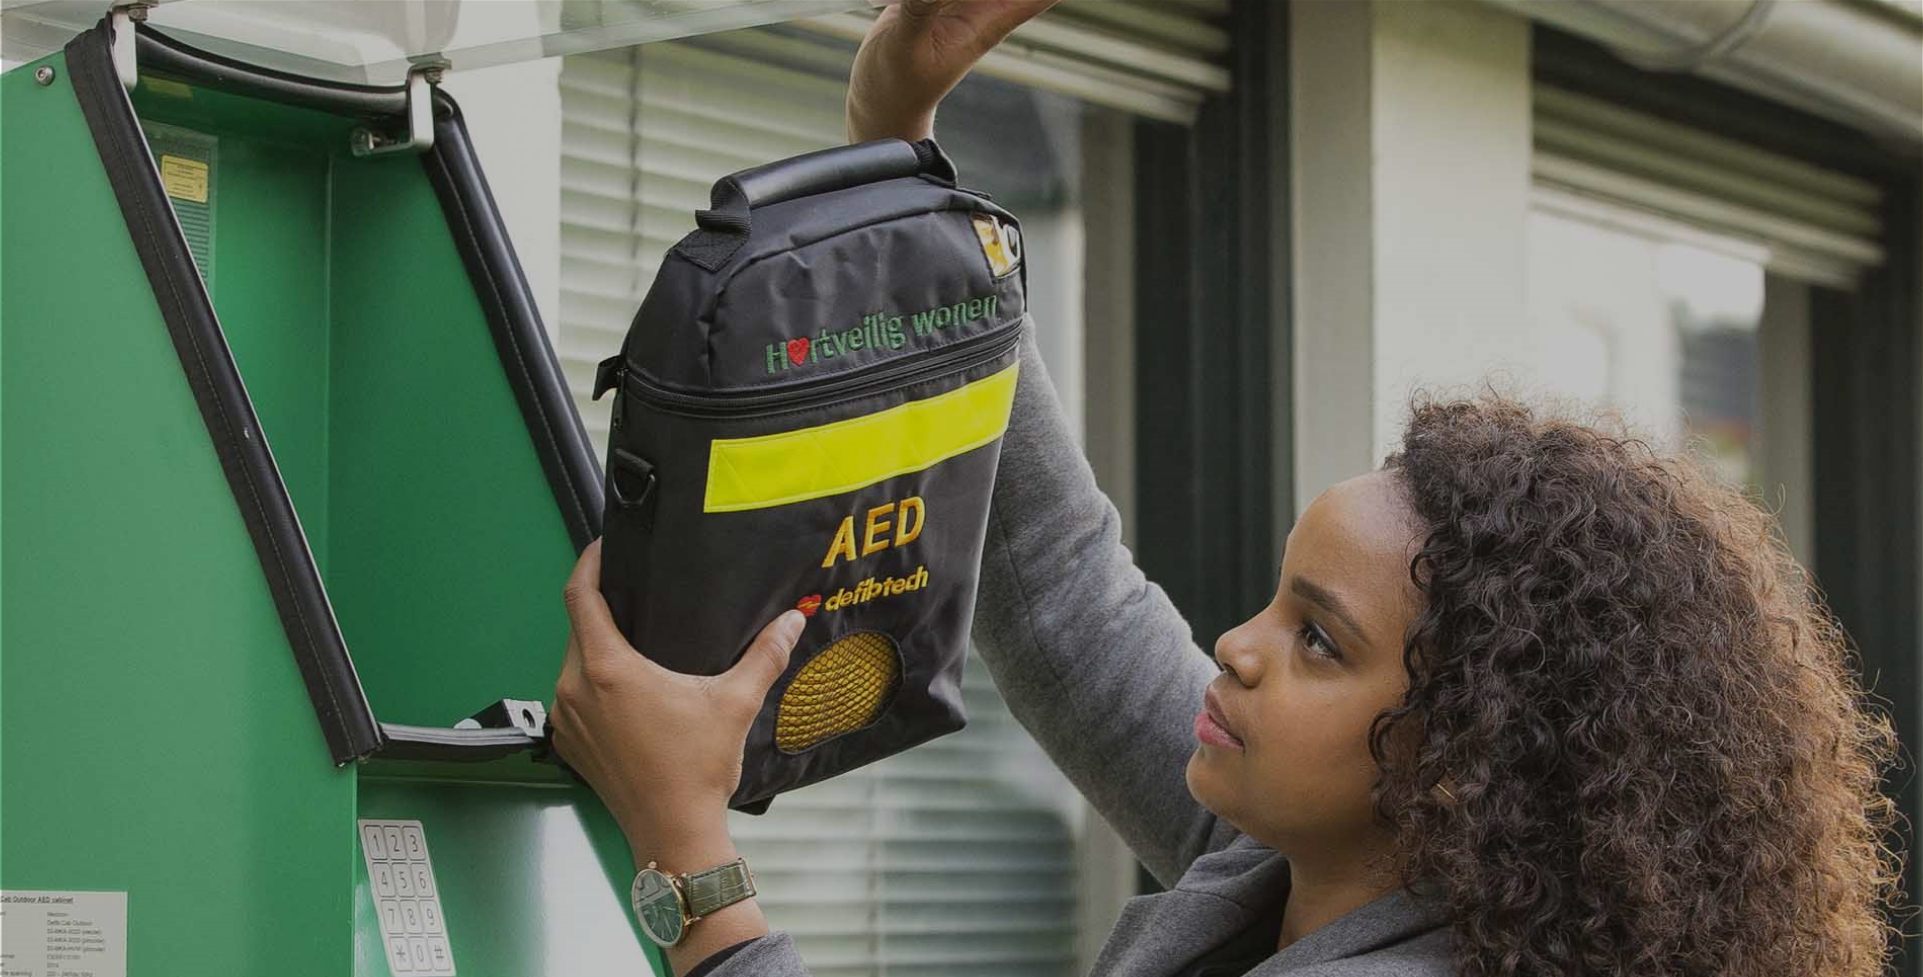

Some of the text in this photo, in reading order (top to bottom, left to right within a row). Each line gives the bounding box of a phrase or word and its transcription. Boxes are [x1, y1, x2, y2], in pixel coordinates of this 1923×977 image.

[912, 295, 998, 337] wonen
[821, 496, 926, 568] AED
[824, 565, 929, 612] defibtech
[373, 833, 418, 852] 1 2 3
[381, 871, 427, 889] 4 5 6
[388, 908, 435, 926] 7 8 9
